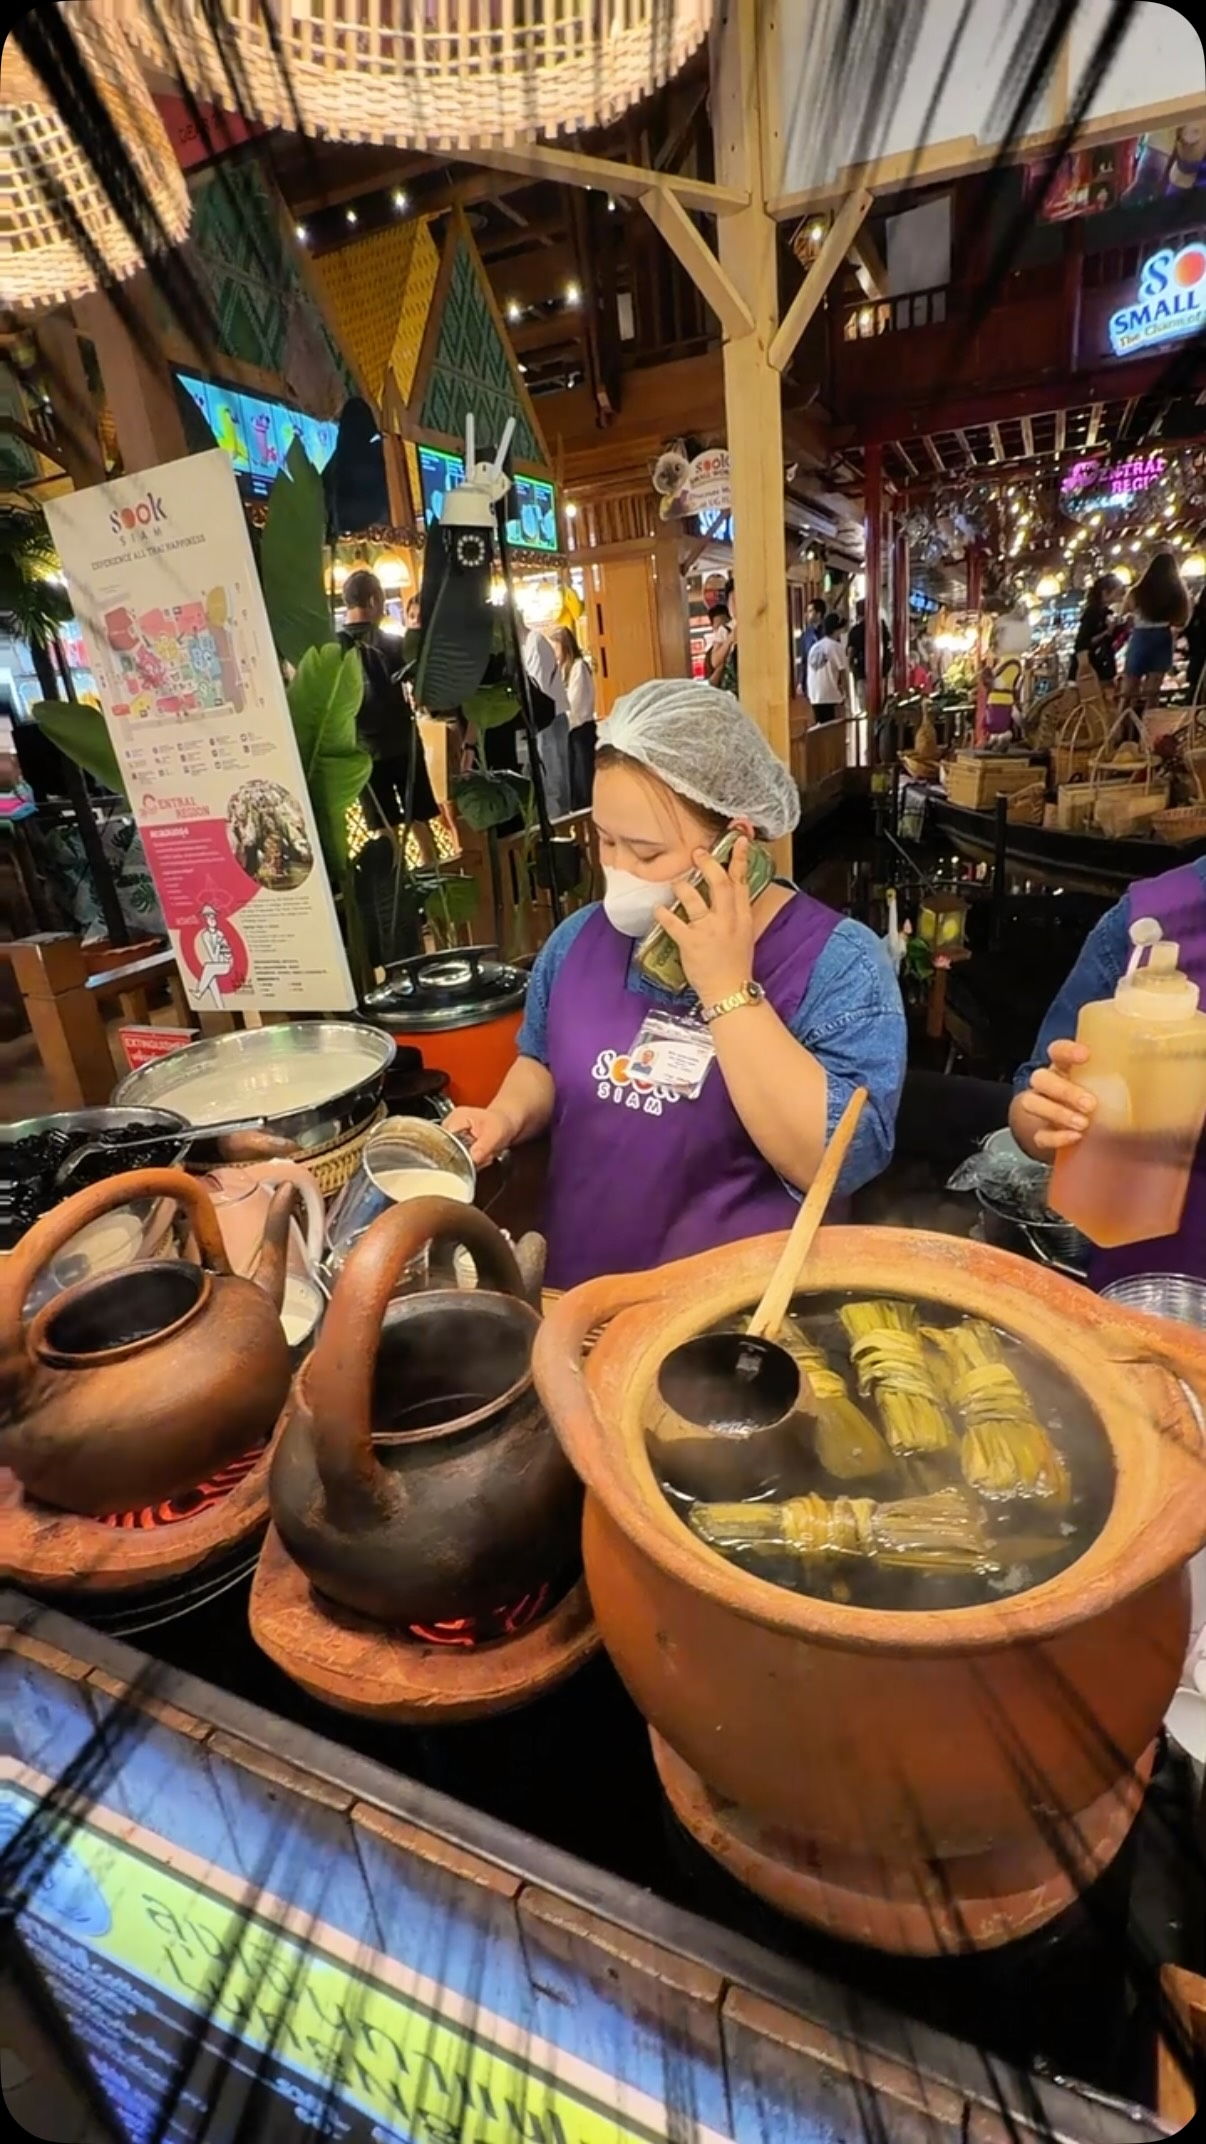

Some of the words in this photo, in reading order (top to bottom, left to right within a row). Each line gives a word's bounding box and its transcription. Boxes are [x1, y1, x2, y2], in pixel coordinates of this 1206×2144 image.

[1114, 290, 1201, 334] SMALL
[1119, 334, 1142, 348] The
[119, 525, 162, 547] SIAM
[91, 553, 132, 571] EXPERIENCE
[133, 549, 146, 561] ALL
[147, 544, 164, 557] THAI
[165, 533, 206, 552] HAPPINESS
[142, 793, 197, 811] CENTRAL
[175, 805, 210, 819] REGION
[597, 1082, 663, 1116] SIAM
